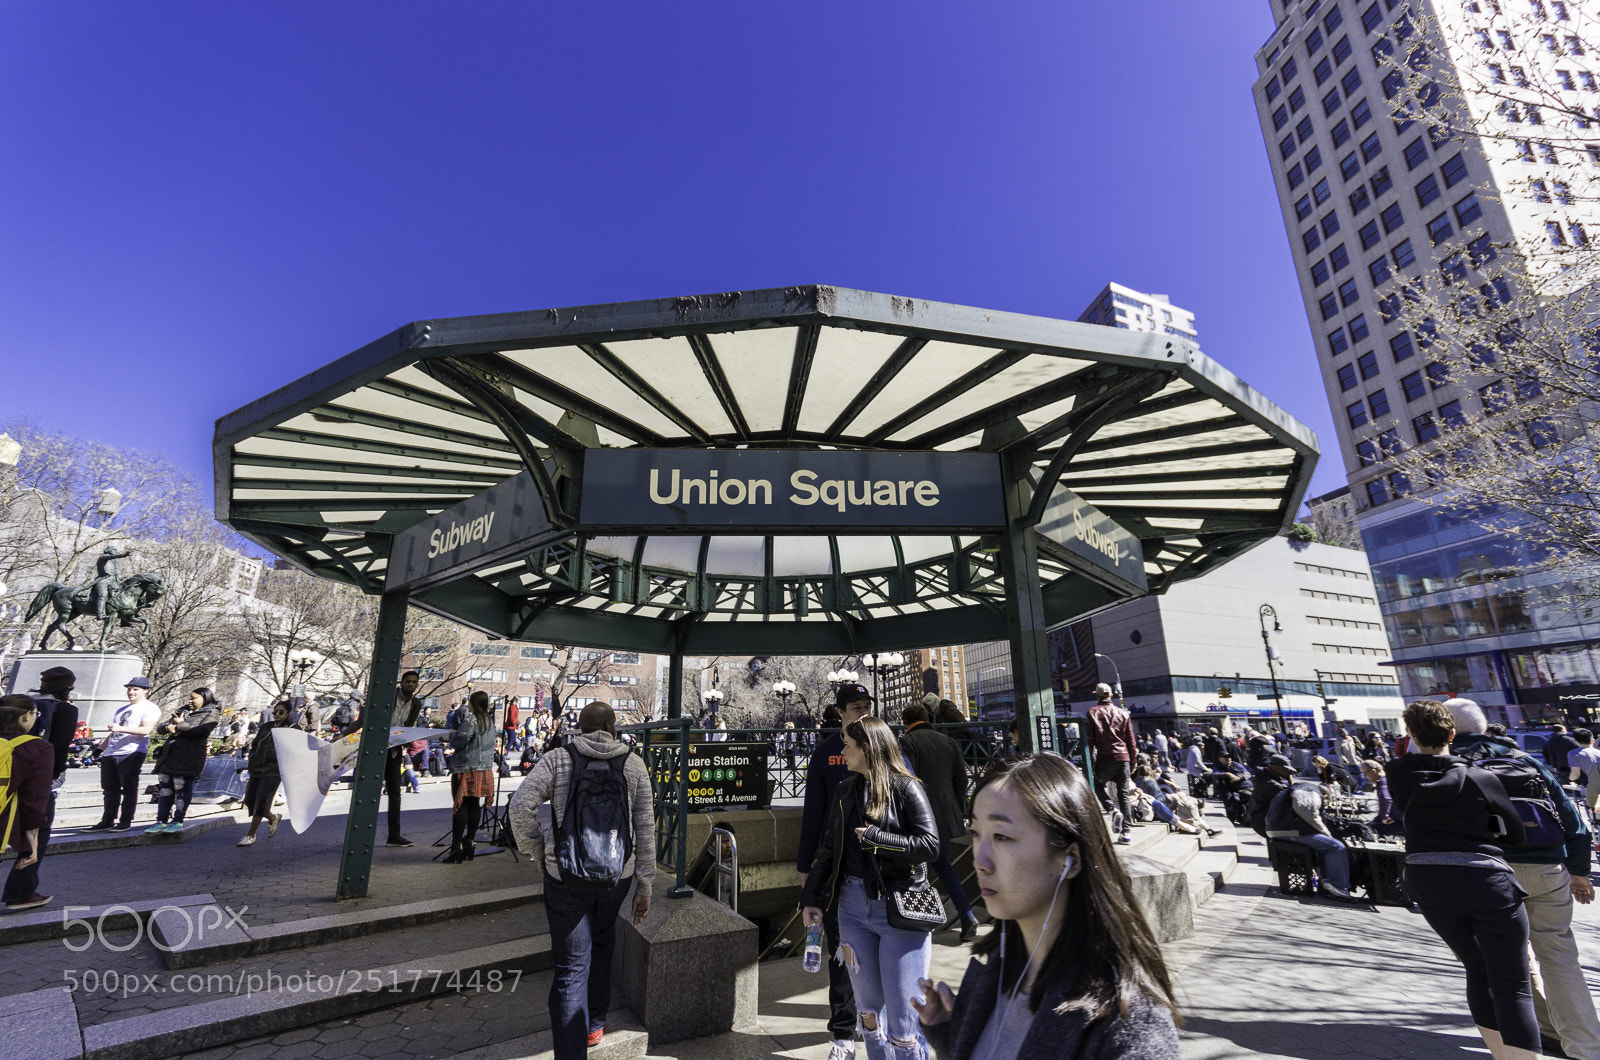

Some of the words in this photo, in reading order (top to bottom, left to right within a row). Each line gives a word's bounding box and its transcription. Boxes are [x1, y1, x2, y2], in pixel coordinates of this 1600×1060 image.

[650, 468, 773, 505] Union
[789, 469, 940, 513] Square
[427, 511, 495, 559] Subway
[1073, 508, 1120, 567] Subway
[682, 757, 711, 767] uare
[713, 755, 750, 766] Station
[690, 769, 700, 781] W
[715, 788, 723, 796] at
[694, 796, 716, 804] Street
[717, 795, 724, 803] &
[724, 795, 730, 803] 4
[731, 794, 757, 802] Avenue
